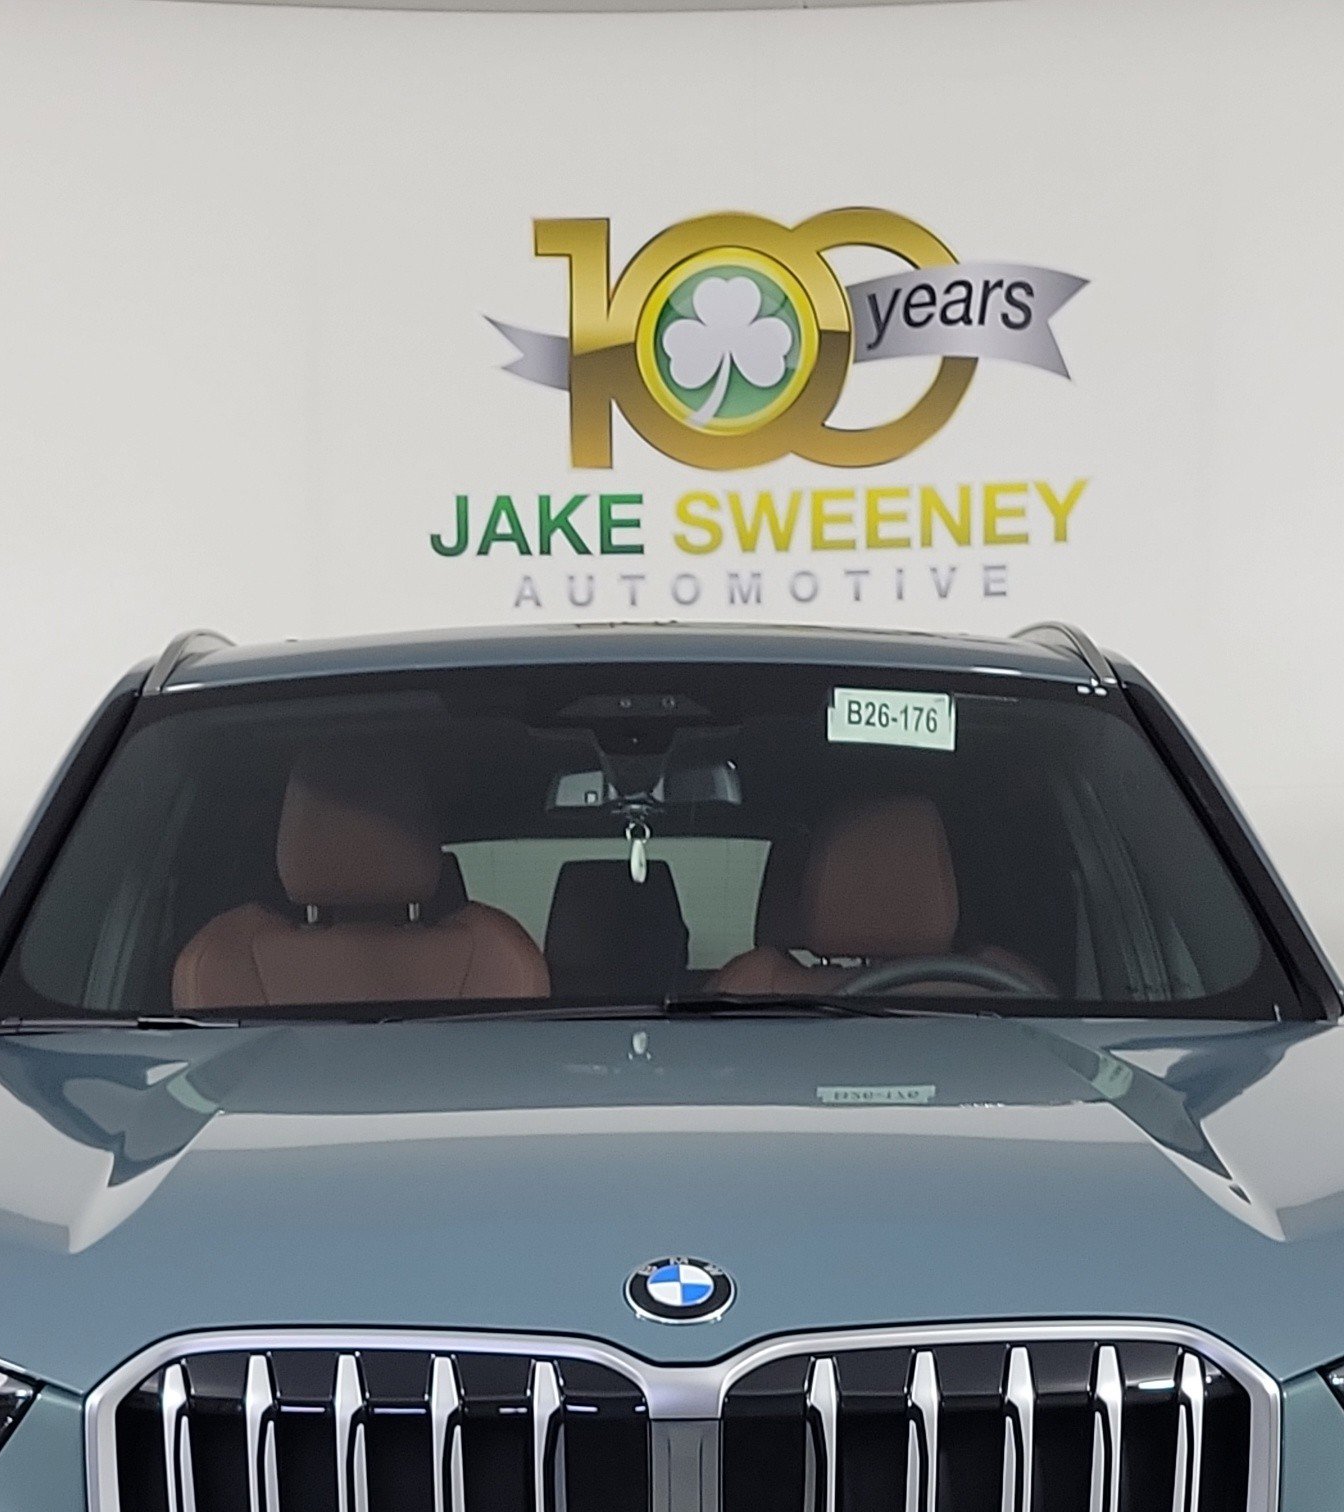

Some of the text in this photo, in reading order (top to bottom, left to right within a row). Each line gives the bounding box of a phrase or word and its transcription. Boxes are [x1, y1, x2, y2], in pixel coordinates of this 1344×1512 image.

[864, 277, 1035, 351] years
[429, 479, 1088, 557] JAKE SWEENEY
[513, 565, 1009, 608] AUTOMOTIVE
[847, 699, 938, 733] B26-176
